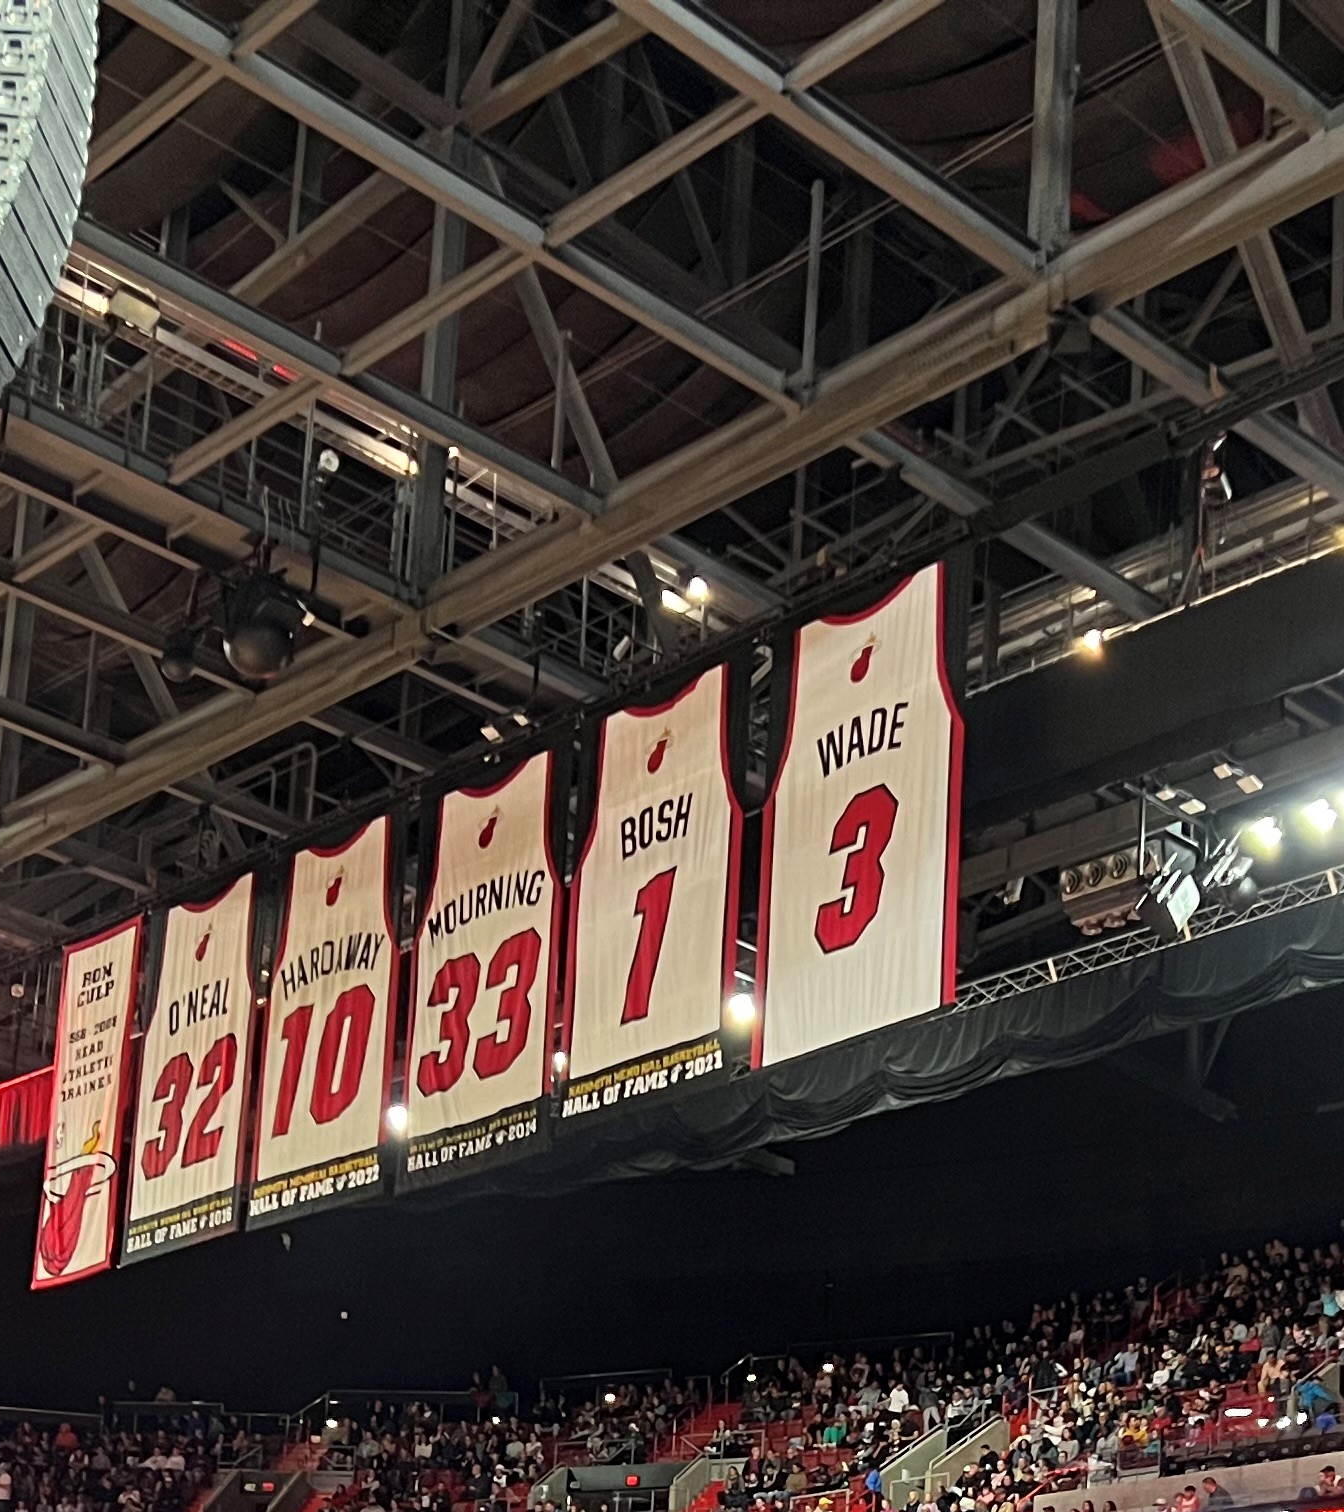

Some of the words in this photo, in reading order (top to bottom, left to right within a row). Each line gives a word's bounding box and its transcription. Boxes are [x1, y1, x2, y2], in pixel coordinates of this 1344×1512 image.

[817, 701, 909, 778] WADE
[621, 792, 693, 860] BOSH
[814, 784, 899, 954] 3
[428, 869, 545, 947] MOURNING
[82, 962, 113, 988] RON
[281, 932, 385, 1000] HARDAWAY
[620, 866, 677, 1026] 1
[77, 980, 114, 1008] CULP
[169, 977, 230, 1036] O'NEAL
[417, 927, 542, 1097] 33
[272, 983, 376, 1139] 10
[562, 1091, 601, 1118] HALL
[603, 1083, 621, 1105] OF
[624, 1069, 668, 1098] FAME
[685, 1050, 723, 1080] 2021
[141, 1032, 238, 1181] 32
[407, 1150, 438, 1172] HALL
[440, 1145, 457, 1163] OF
[458, 1134, 492, 1159] FAME
[508, 1118, 537, 1142] 2014
[250, 1190, 279, 1217] HALL
[281, 1187, 297, 1207] OF
[299, 1177, 334, 1202] FAME
[348, 1164, 380, 1191] 2022
[154, 1226, 168, 1244] OF
[169, 1218, 197, 1240] FAME
